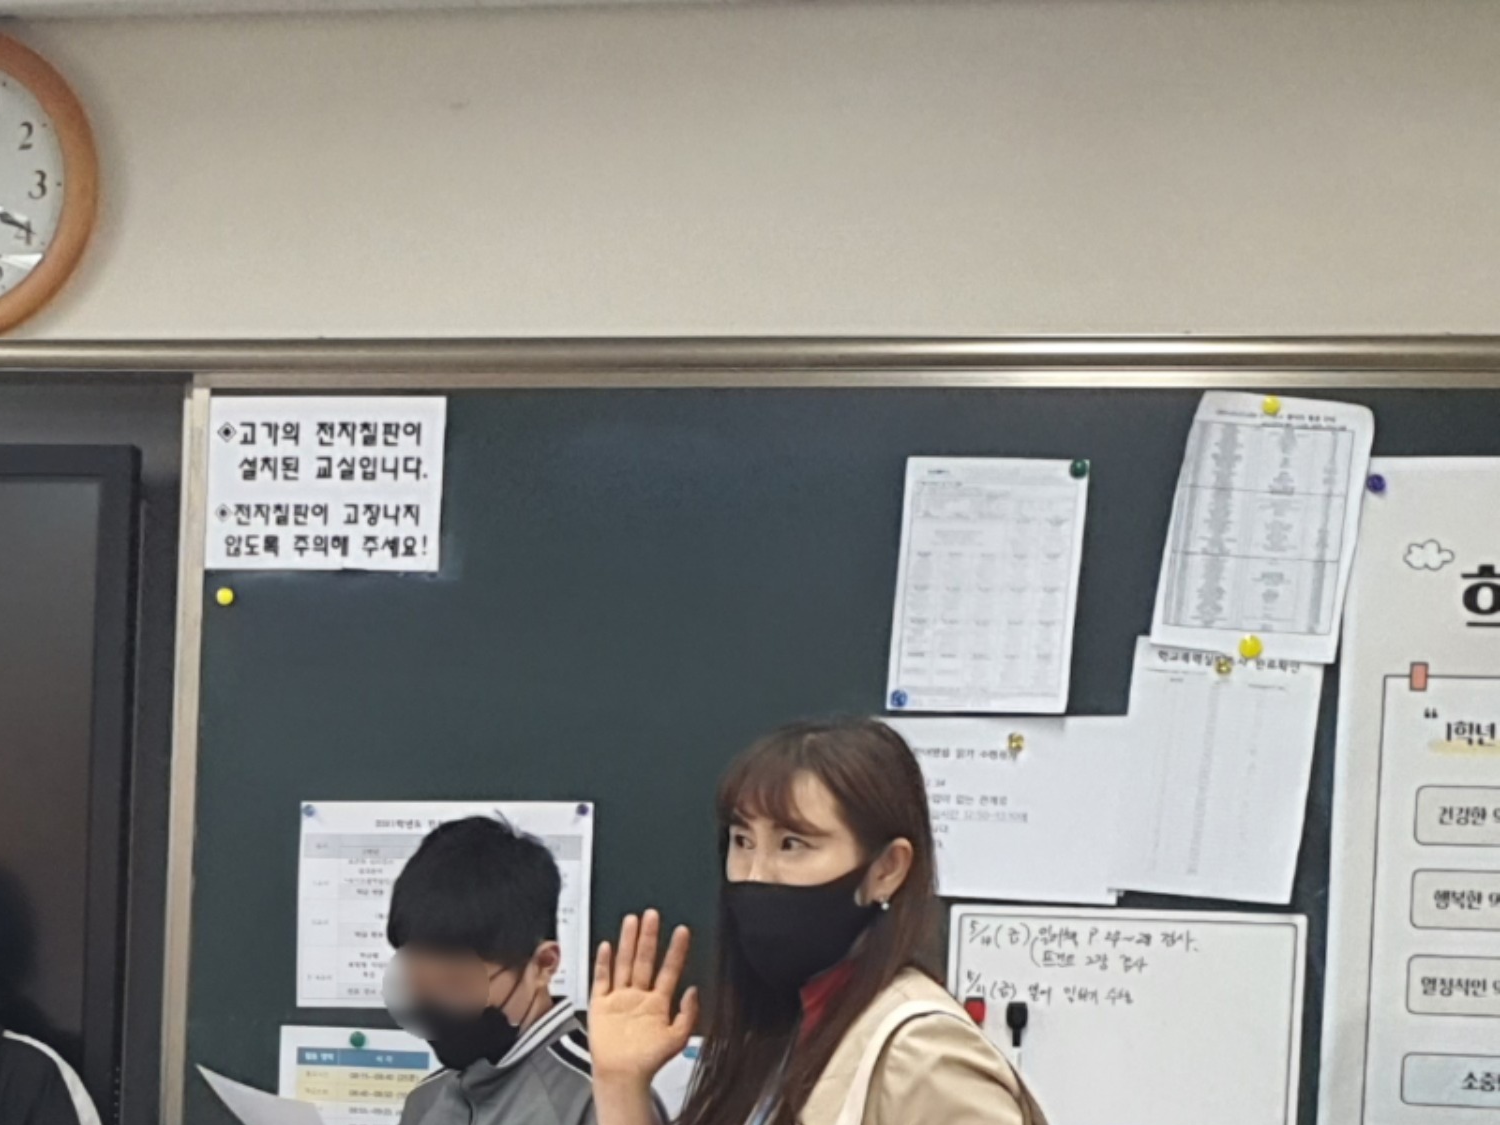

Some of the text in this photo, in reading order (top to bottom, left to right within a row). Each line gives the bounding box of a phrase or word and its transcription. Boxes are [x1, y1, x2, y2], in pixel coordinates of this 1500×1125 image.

[18, 121, 34, 150] 2
[27, 170, 47, 199] 3
[238, 421, 422, 447] 고가의 전자칠판이
[238, 456, 428, 481] 설치된 교실입니다.
[233, 503, 420, 527] 전자칠판이 고장나지
[224, 535, 428, 559] 않도록 주의해 주세요!
[1438, 805, 1488, 826] 건강한
[1433, 889, 1483, 911] 행복한
[1420, 976, 1487, 998] 열정적인
[1461, 1070, 1500, 1093] 소중
